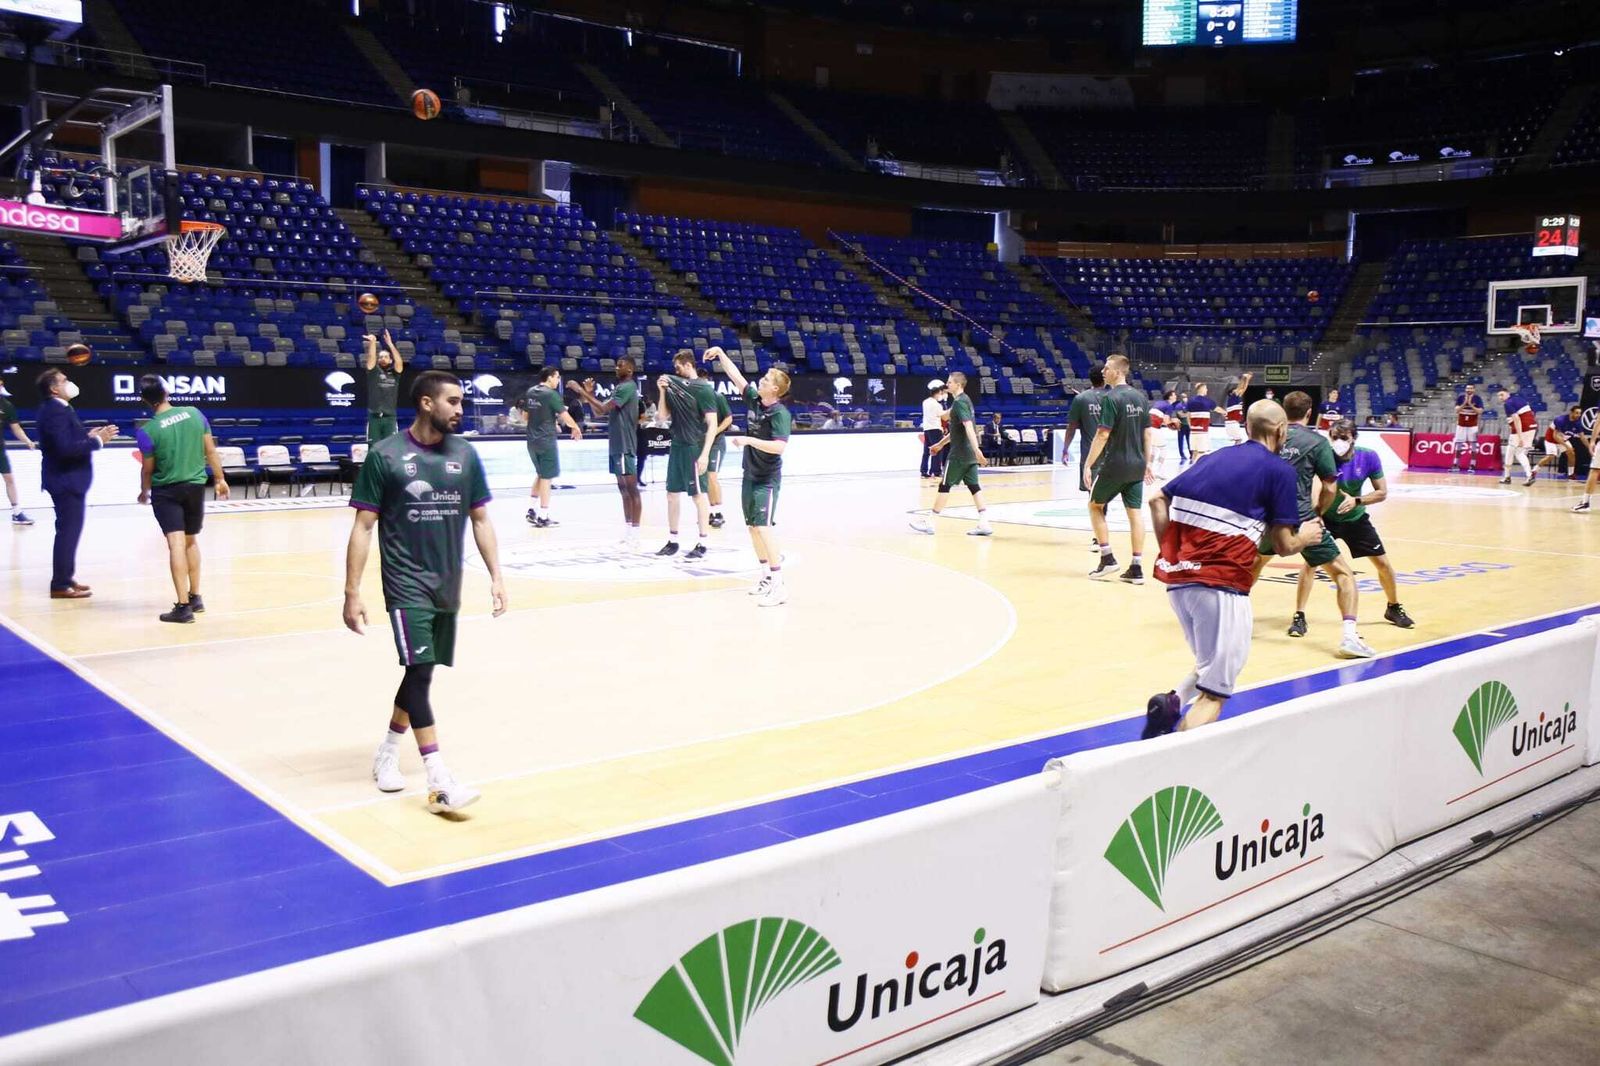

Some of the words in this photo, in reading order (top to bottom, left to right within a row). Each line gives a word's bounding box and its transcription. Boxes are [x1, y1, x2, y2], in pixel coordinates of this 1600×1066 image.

[1537, 229, 1562, 247] 24
[1542, 217, 1566, 227] 8:29
[431, 491, 461, 503] Unicaja
[1511, 702, 1577, 757] Unicaja
[1214, 803, 1325, 881] Unicaja
[827, 927, 1007, 1033] Unicaja
